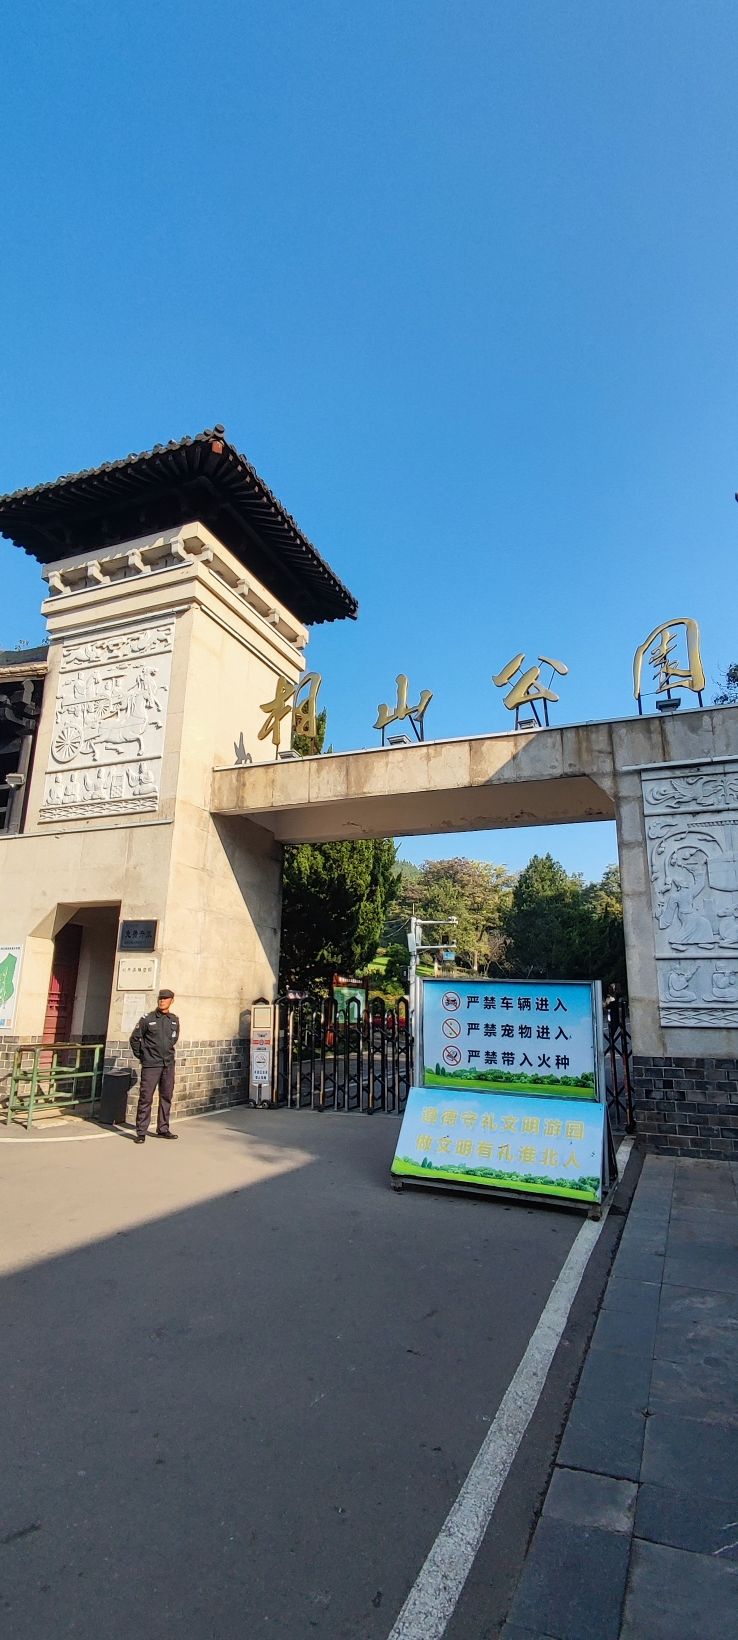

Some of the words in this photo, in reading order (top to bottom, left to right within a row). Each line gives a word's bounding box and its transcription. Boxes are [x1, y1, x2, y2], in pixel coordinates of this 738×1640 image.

[466, 995, 568, 1012] 严禁车辆进入
[467, 1023, 569, 1040] 严禁宠物进入
[467, 1050, 570, 1070] 严禁带入火种
